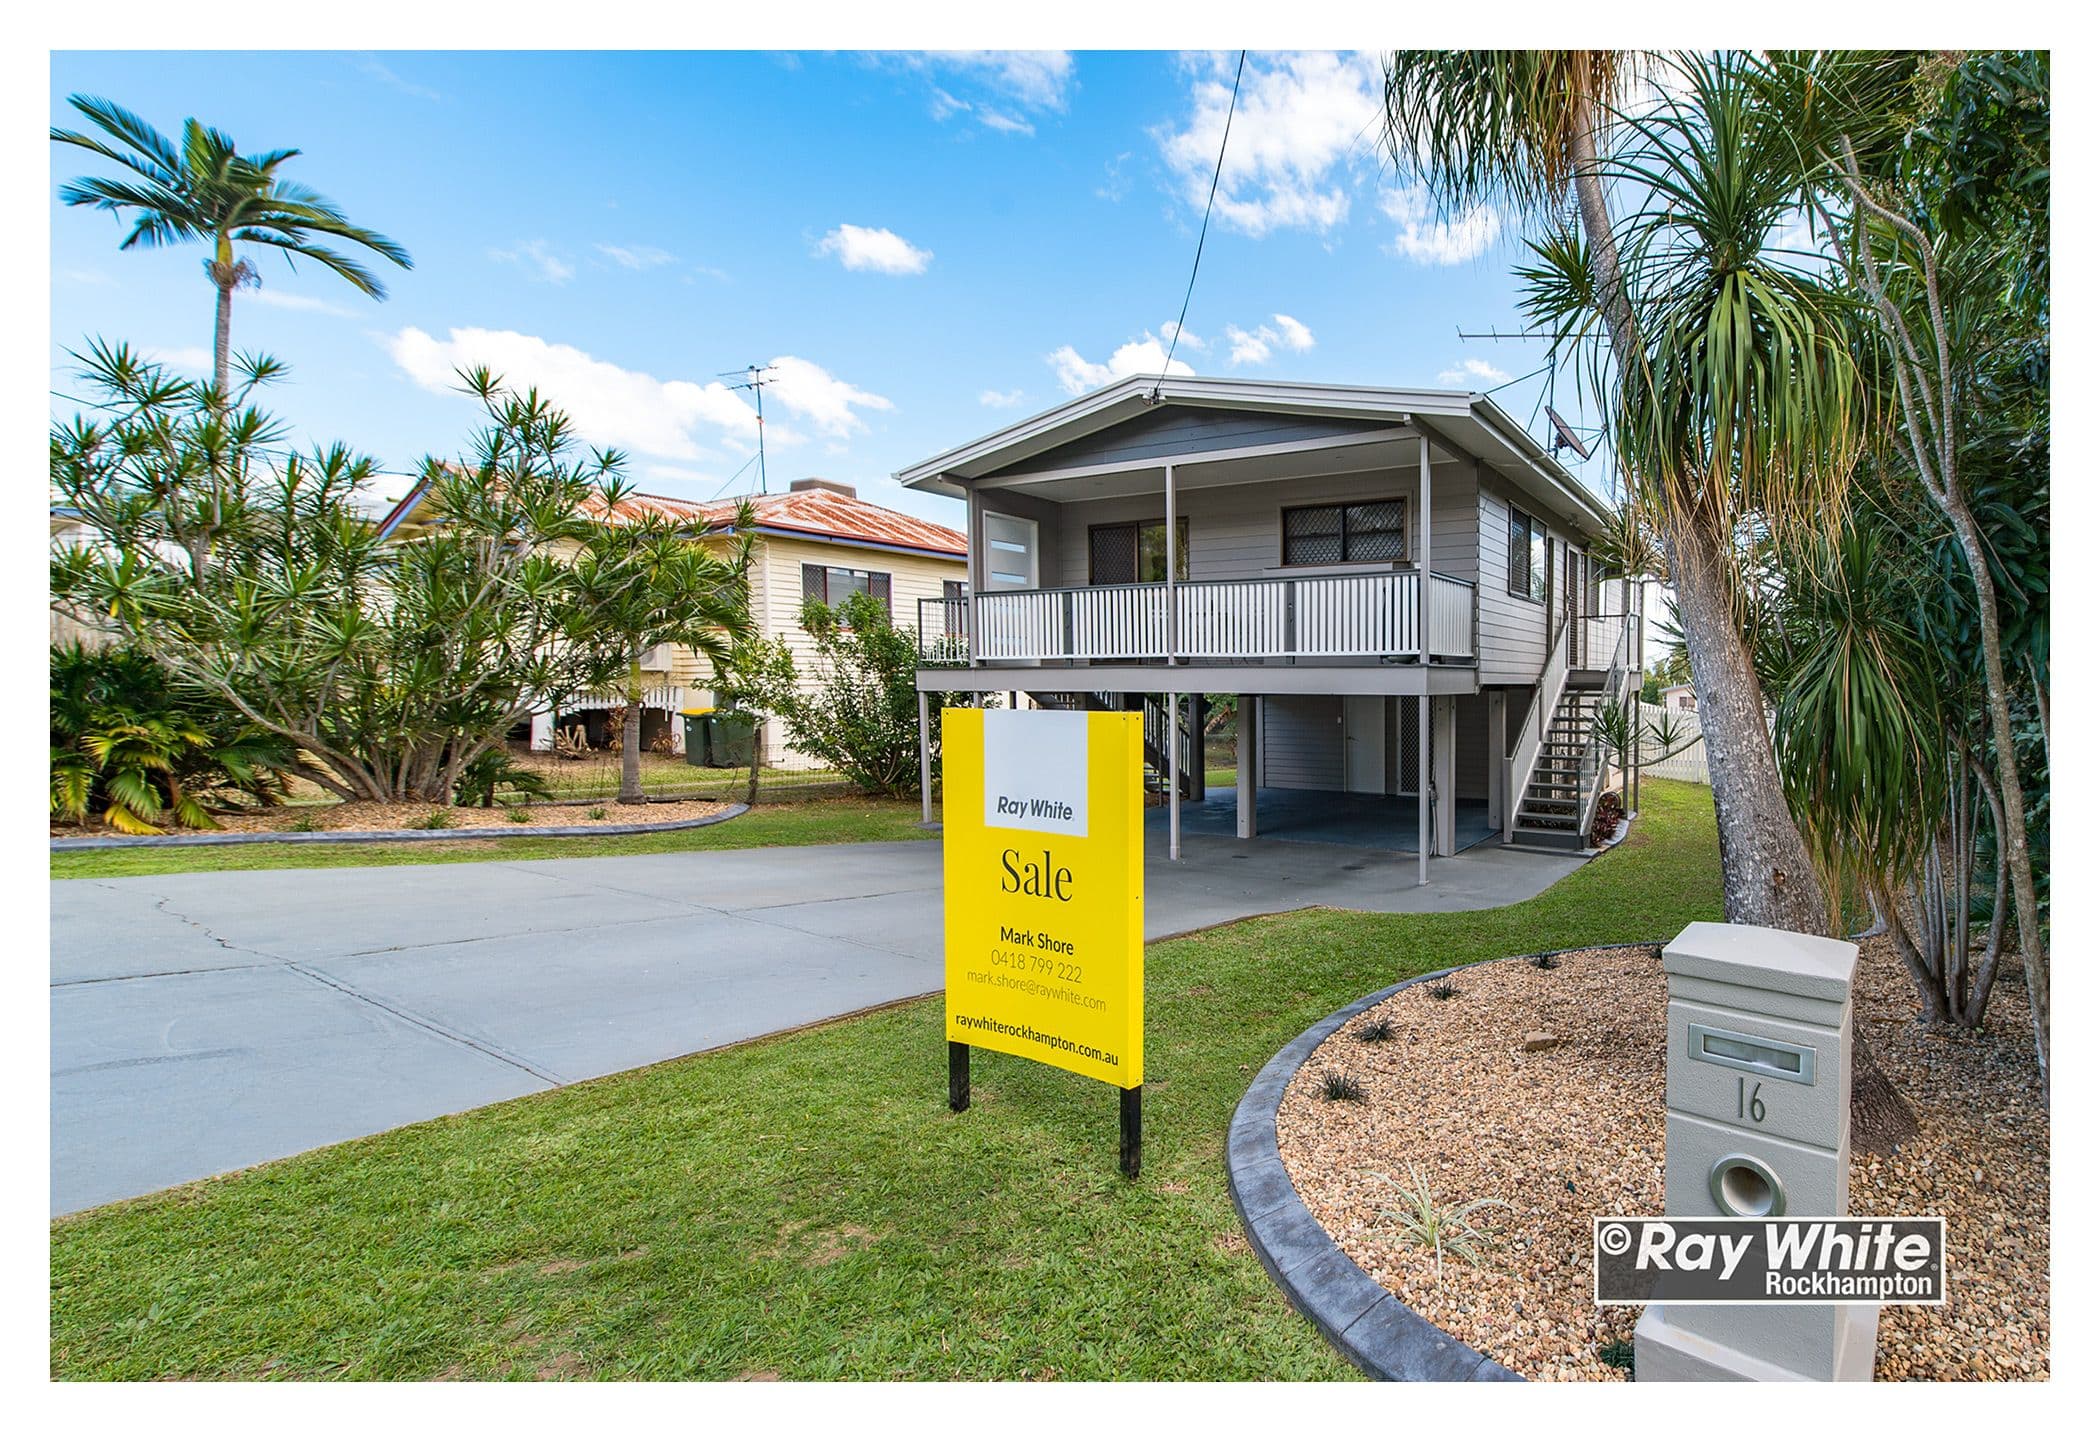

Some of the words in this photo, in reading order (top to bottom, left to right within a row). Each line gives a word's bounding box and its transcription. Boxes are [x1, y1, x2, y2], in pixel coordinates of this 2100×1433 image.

[997, 795, 1028, 819] Ray
[1030, 798, 1073, 821] White
[1001, 848, 1073, 902] Sale
[1000, 926, 1035, 948] Mark
[1037, 932, 1075, 956] Shore
[991, 949, 1026, 971] 0418
[1029, 956, 1054, 976] 799
[1057, 962, 1083, 984] 222
[967, 969, 1107, 1012] mark.shore@raywhite.com
[955, 1013, 1120, 1067] raywhiterockhampton.com.au
[1736, 1076, 1767, 1123] 16
